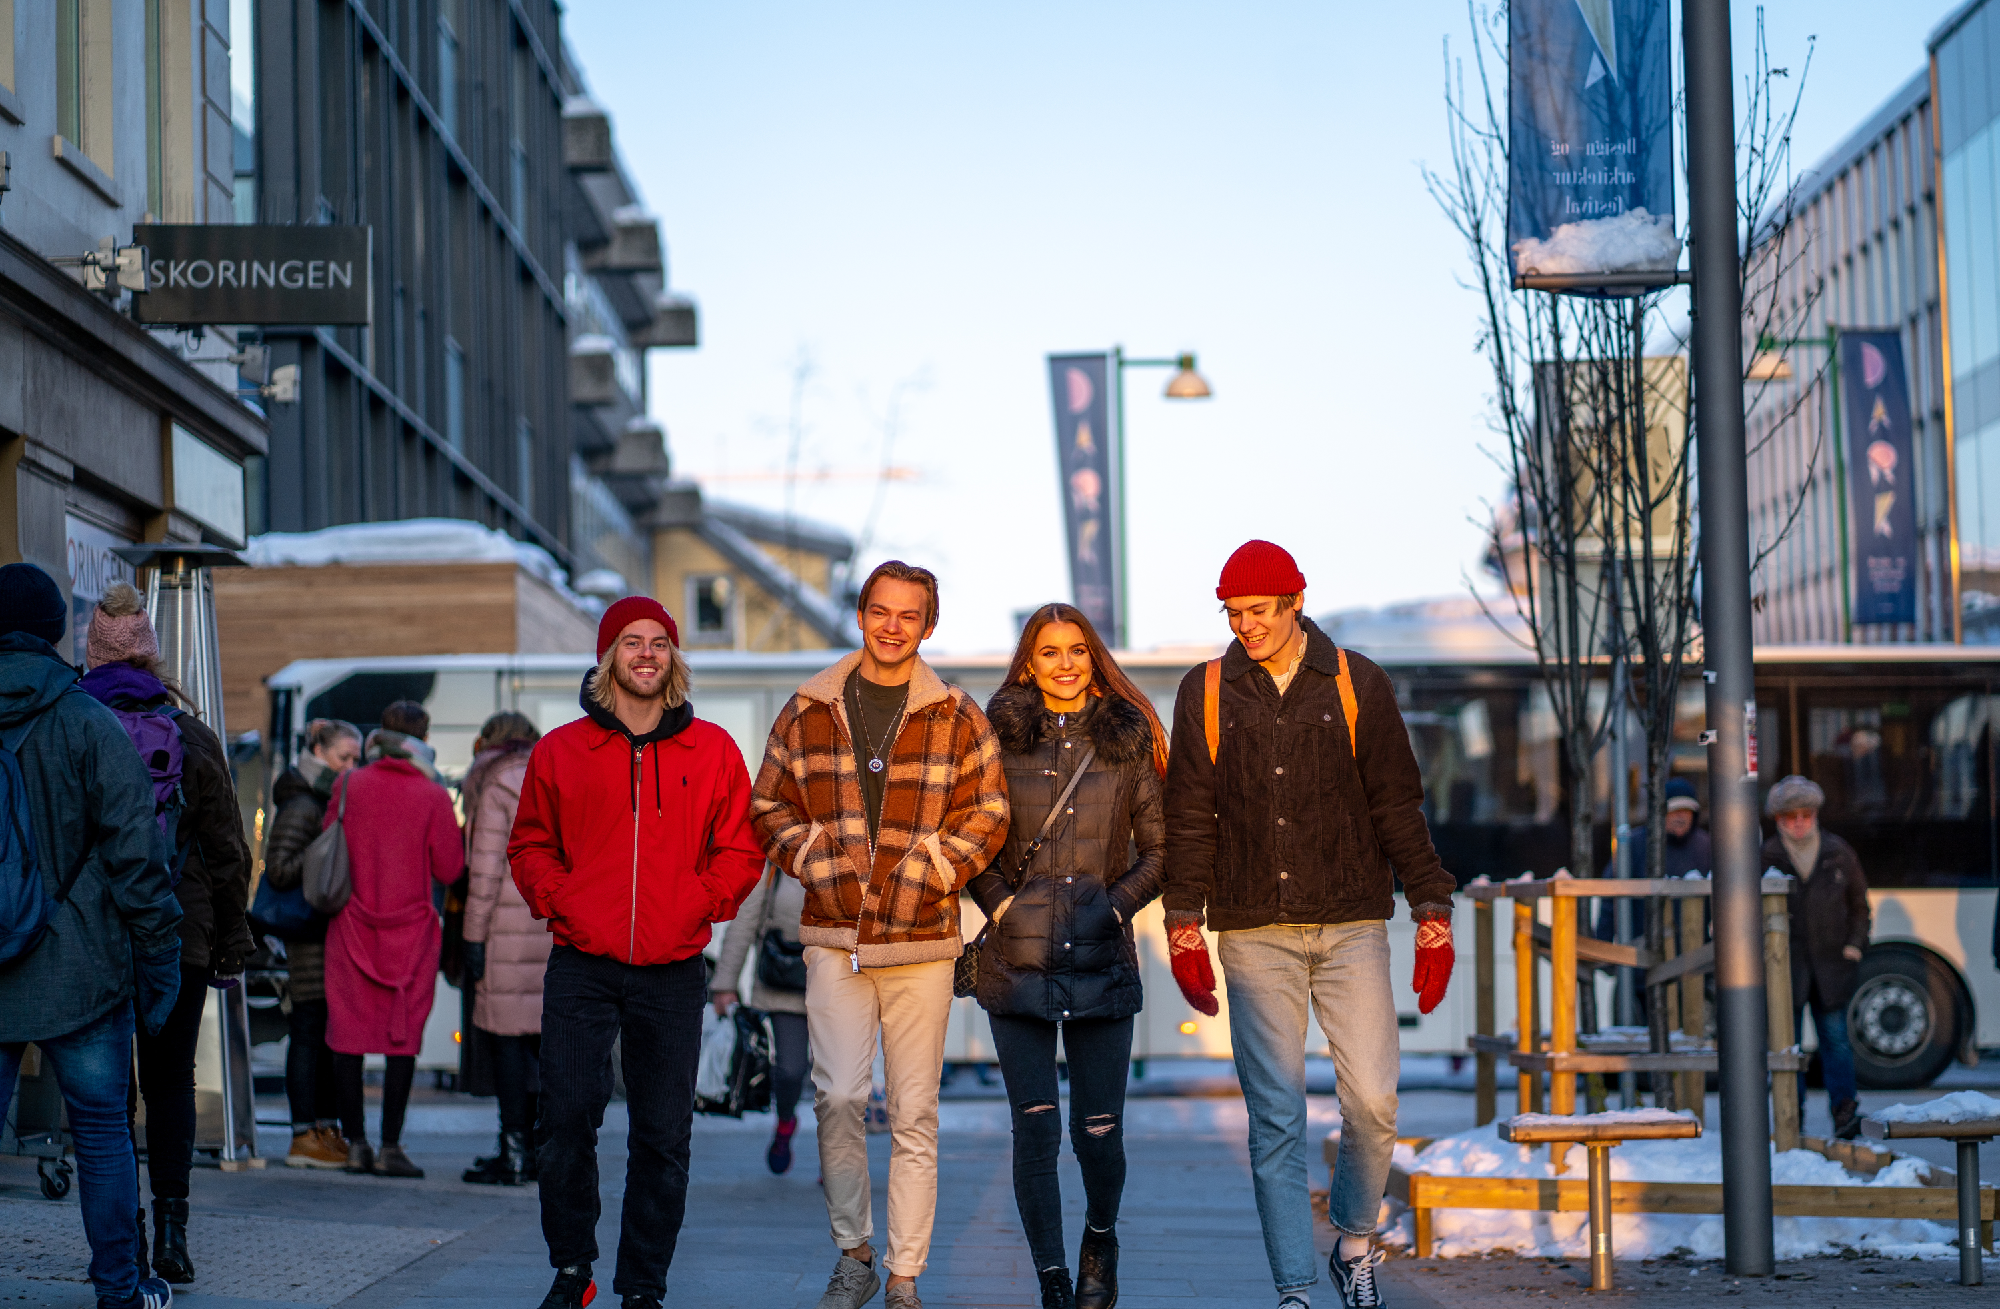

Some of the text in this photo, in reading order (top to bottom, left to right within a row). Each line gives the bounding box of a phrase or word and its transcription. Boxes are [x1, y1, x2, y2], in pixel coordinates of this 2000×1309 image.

[150, 259, 353, 289] SKORINGEN
[1065, 367, 1102, 562] DARK
[1861, 341, 1899, 538] DARK
